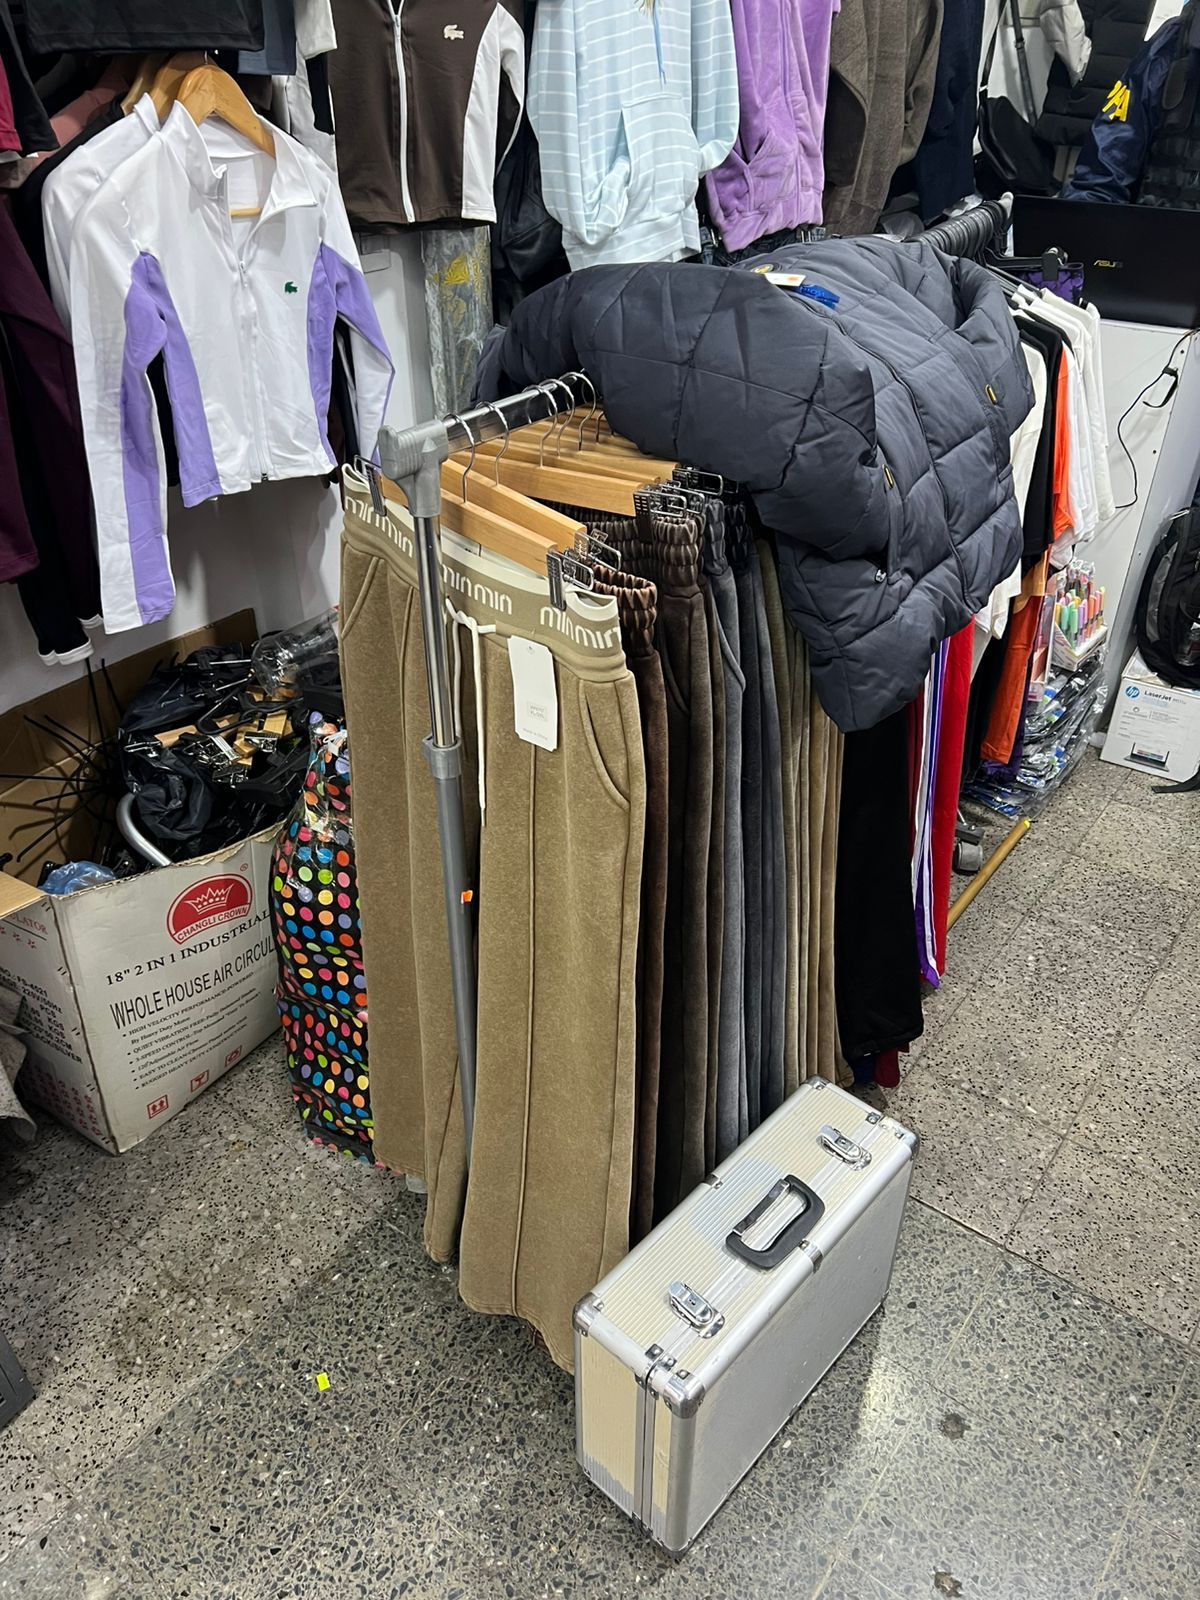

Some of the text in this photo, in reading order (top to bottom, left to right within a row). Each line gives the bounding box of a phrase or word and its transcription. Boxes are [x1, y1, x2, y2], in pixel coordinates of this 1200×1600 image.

[1125, 686, 1172, 701] hp LaserJet
[177, 907, 247, 941] CHANGLI CROWN
[106, 909, 271, 986] 18" 2 IN 1 INDUSTRIAL
[110, 935, 275, 1029] WHOLE HOUSE AIR CIRCUL
[129, 1026, 146, 1036] HIGH
[148, 1011, 180, 1028] VELOCITY
[133, 1042, 153, 1054] QUIET
[153, 1027, 189, 1047] VIBRATION
